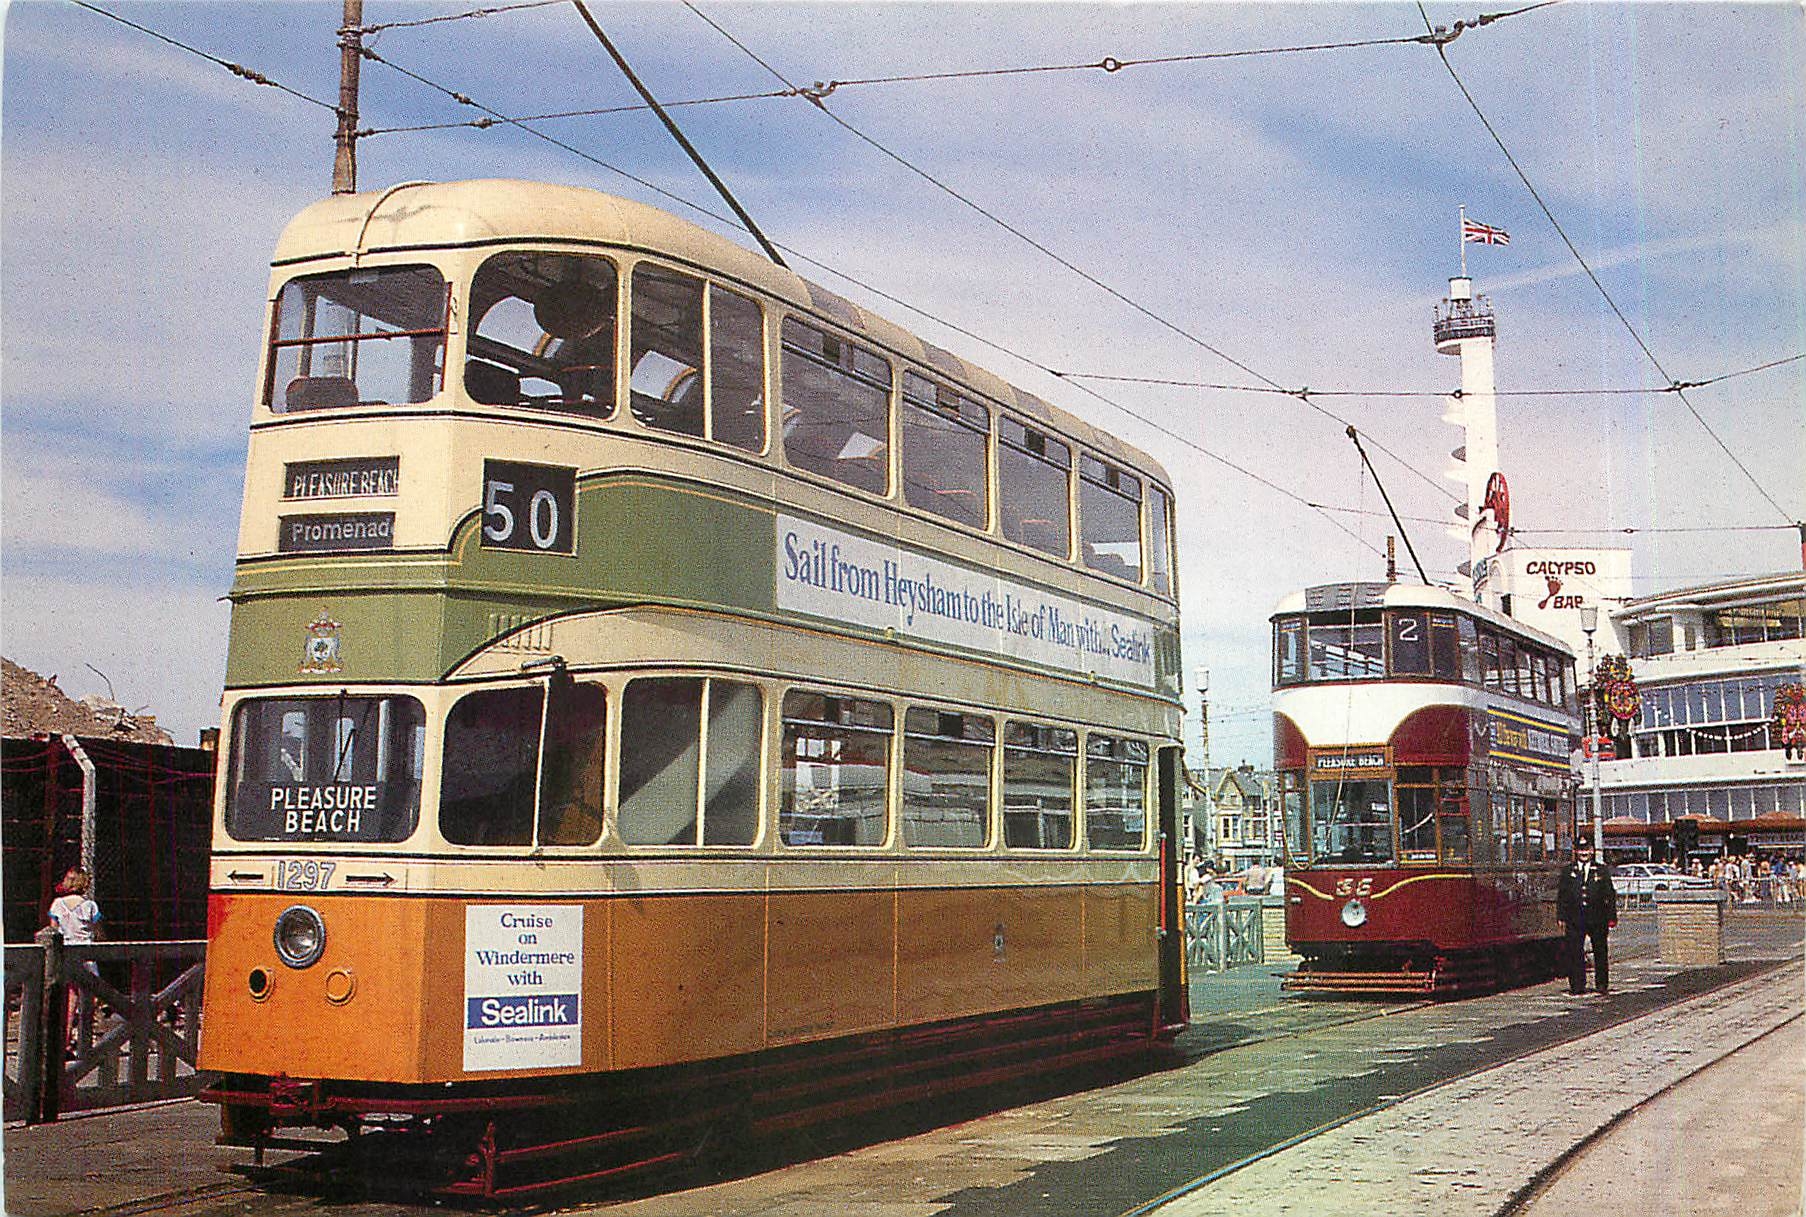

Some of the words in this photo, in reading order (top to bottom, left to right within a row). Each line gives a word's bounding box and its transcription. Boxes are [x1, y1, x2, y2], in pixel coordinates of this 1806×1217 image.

[293, 471, 359, 496] PLEASURE
[483, 480, 560, 550] 50
[291, 518, 393, 542] Promenad
[1526, 561, 1597, 575] CALYPSO
[784, 532, 827, 589] Sail
[829, 543, 880, 602] from
[884, 559, 962, 627] Heysham
[964, 587, 979, 624] to
[981, 590, 1004, 631] the
[1006, 595, 1028, 636] Isle
[1031, 604, 1046, 640] of
[1048, 606, 1075, 648] Man
[1111, 623, 1152, 665] Sealink
[1553, 595, 1584, 609] BAR
[1399, 619, 1418, 641] 2
[271, 786, 377, 810] PLEASURE
[285, 809, 361, 833] BEACH
[276, 861, 336, 890] 1297
[501, 913, 553, 929] Cruise
[518, 934, 537, 945] on
[476, 951, 575, 965] Windermere
[507, 970, 543, 986] with
[481, 998, 567, 1026] Sealink
